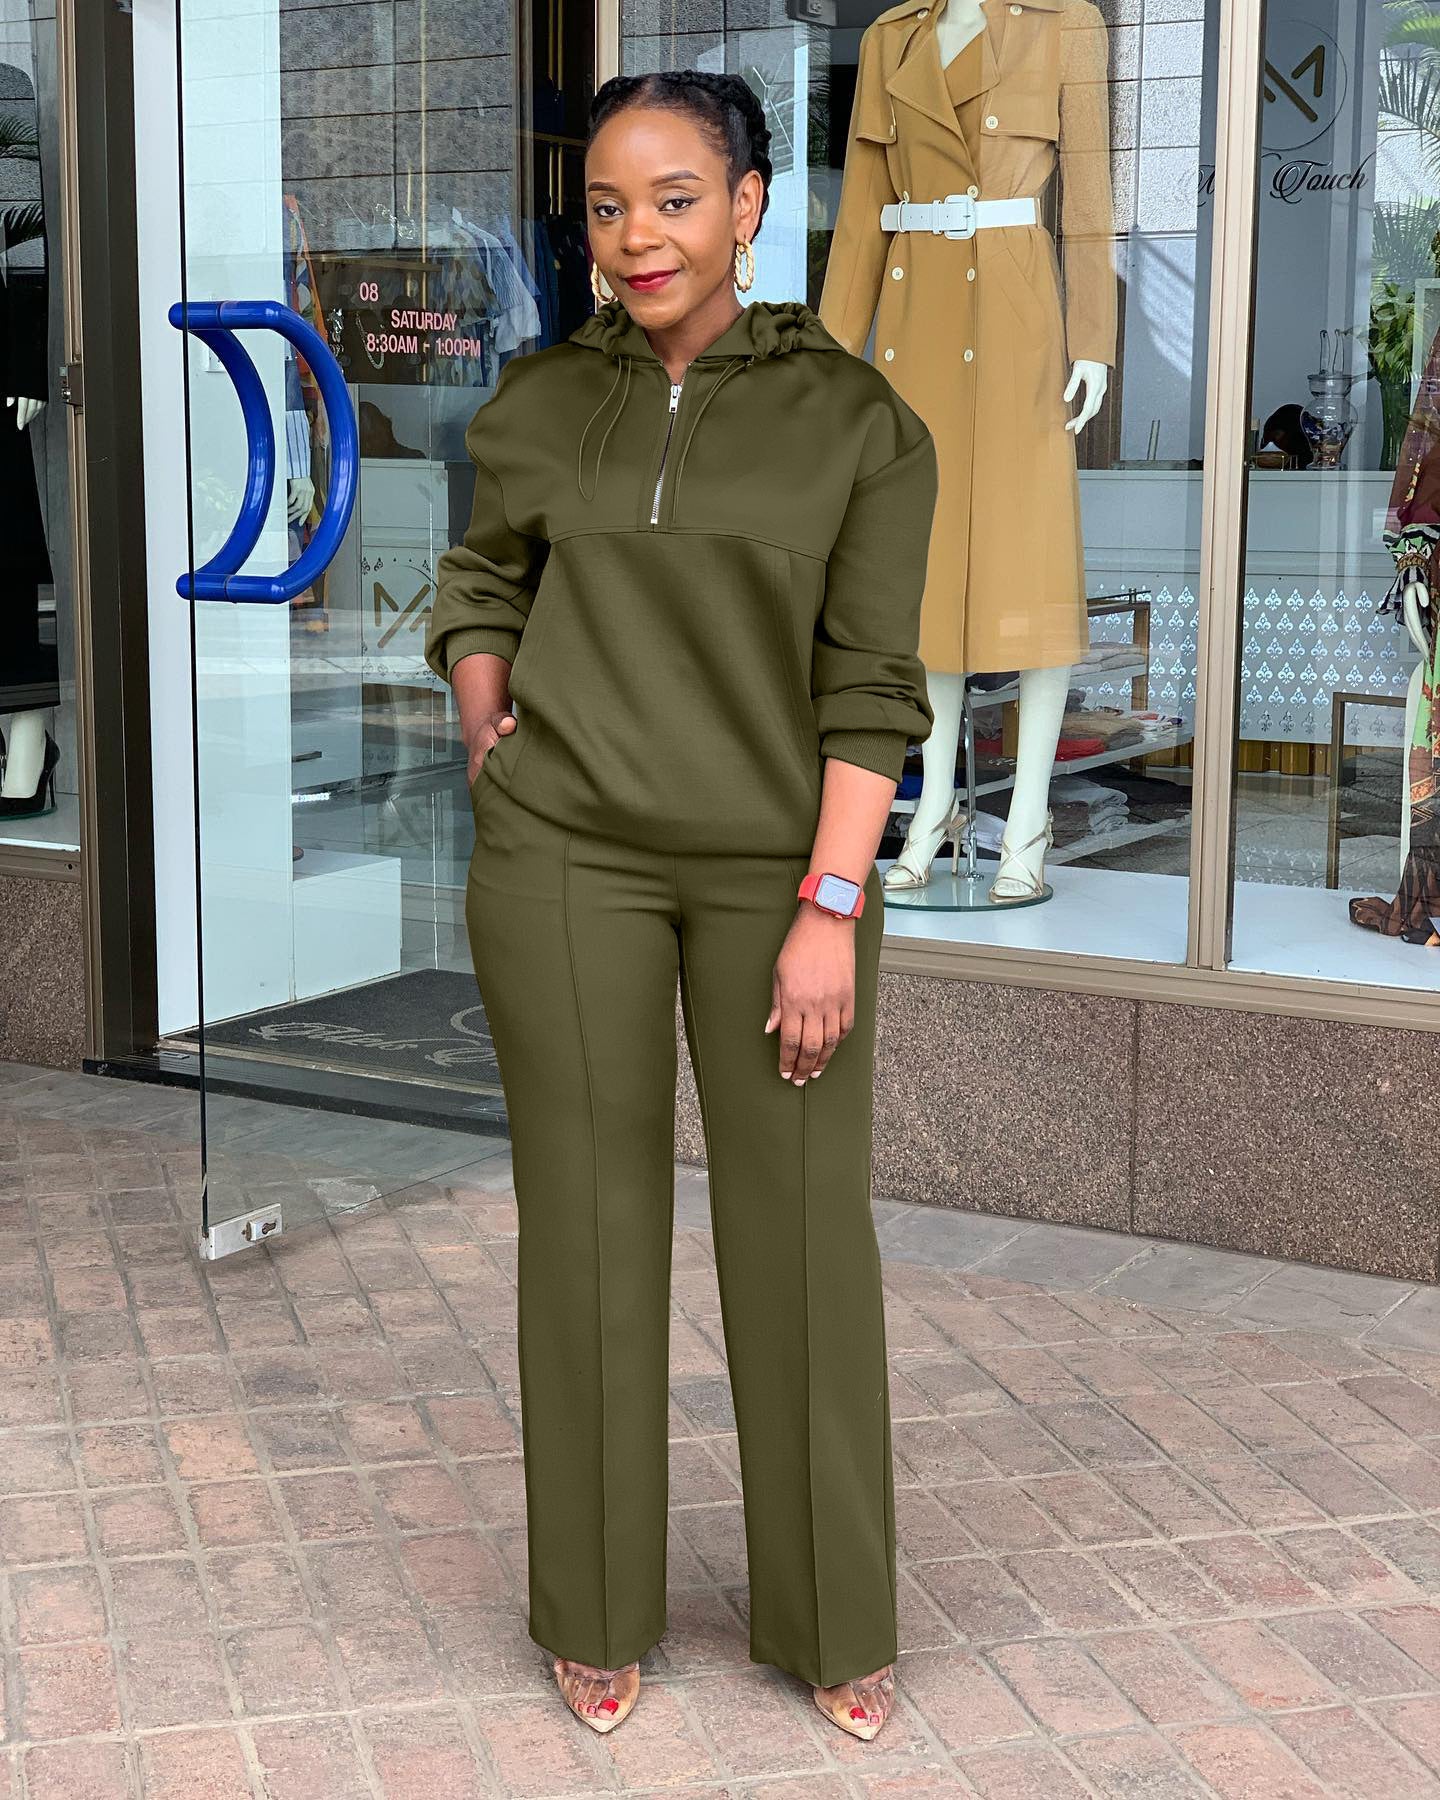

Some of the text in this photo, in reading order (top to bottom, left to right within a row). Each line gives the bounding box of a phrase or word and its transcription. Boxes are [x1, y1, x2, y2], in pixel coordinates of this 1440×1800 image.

[1270, 152, 1376, 204] Touch
[359, 282, 379, 302] 08
[391, 309, 457, 331] SATURDAY
[366, 333, 418, 354] 8:30AM
[436, 337, 481, 357] 1:00PM
